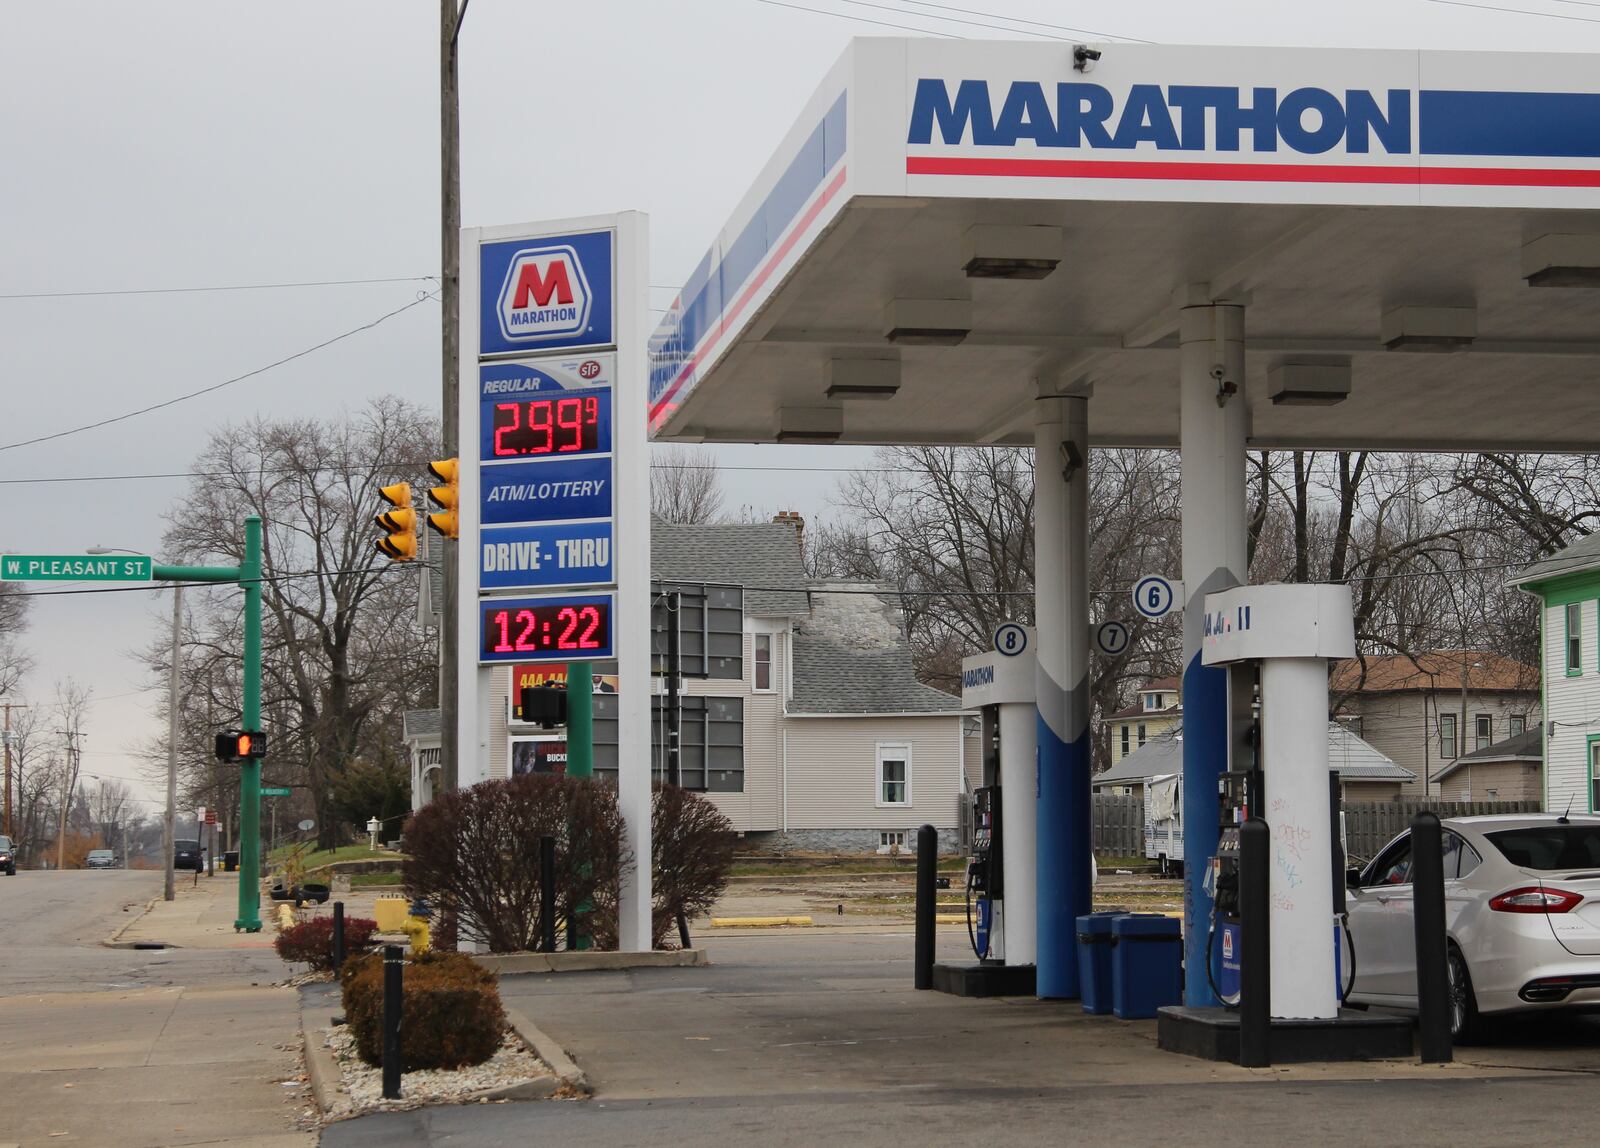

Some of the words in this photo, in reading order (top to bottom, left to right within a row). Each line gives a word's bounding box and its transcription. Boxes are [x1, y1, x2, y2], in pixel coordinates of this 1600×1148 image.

[907, 78, 1411, 154] MARATHON
[512, 259, 574, 309] M
[511, 307, 576, 326] MARATHON
[581, 362, 599, 377] STP
[483, 377, 541, 394] REGULAR
[487, 480, 605, 502] ATM/LOTTERY
[7, 561, 23, 575] W.
[29, 561, 118, 575] PLEASANT
[124, 561, 146, 576] ST.
[1148, 586, 1160, 609] 6
[495, 607, 599, 652] 12:22
[1108, 629, 1118, 647] 7
[1005, 631, 1016, 650] 8
[962, 665, 994, 688] MARATHON
